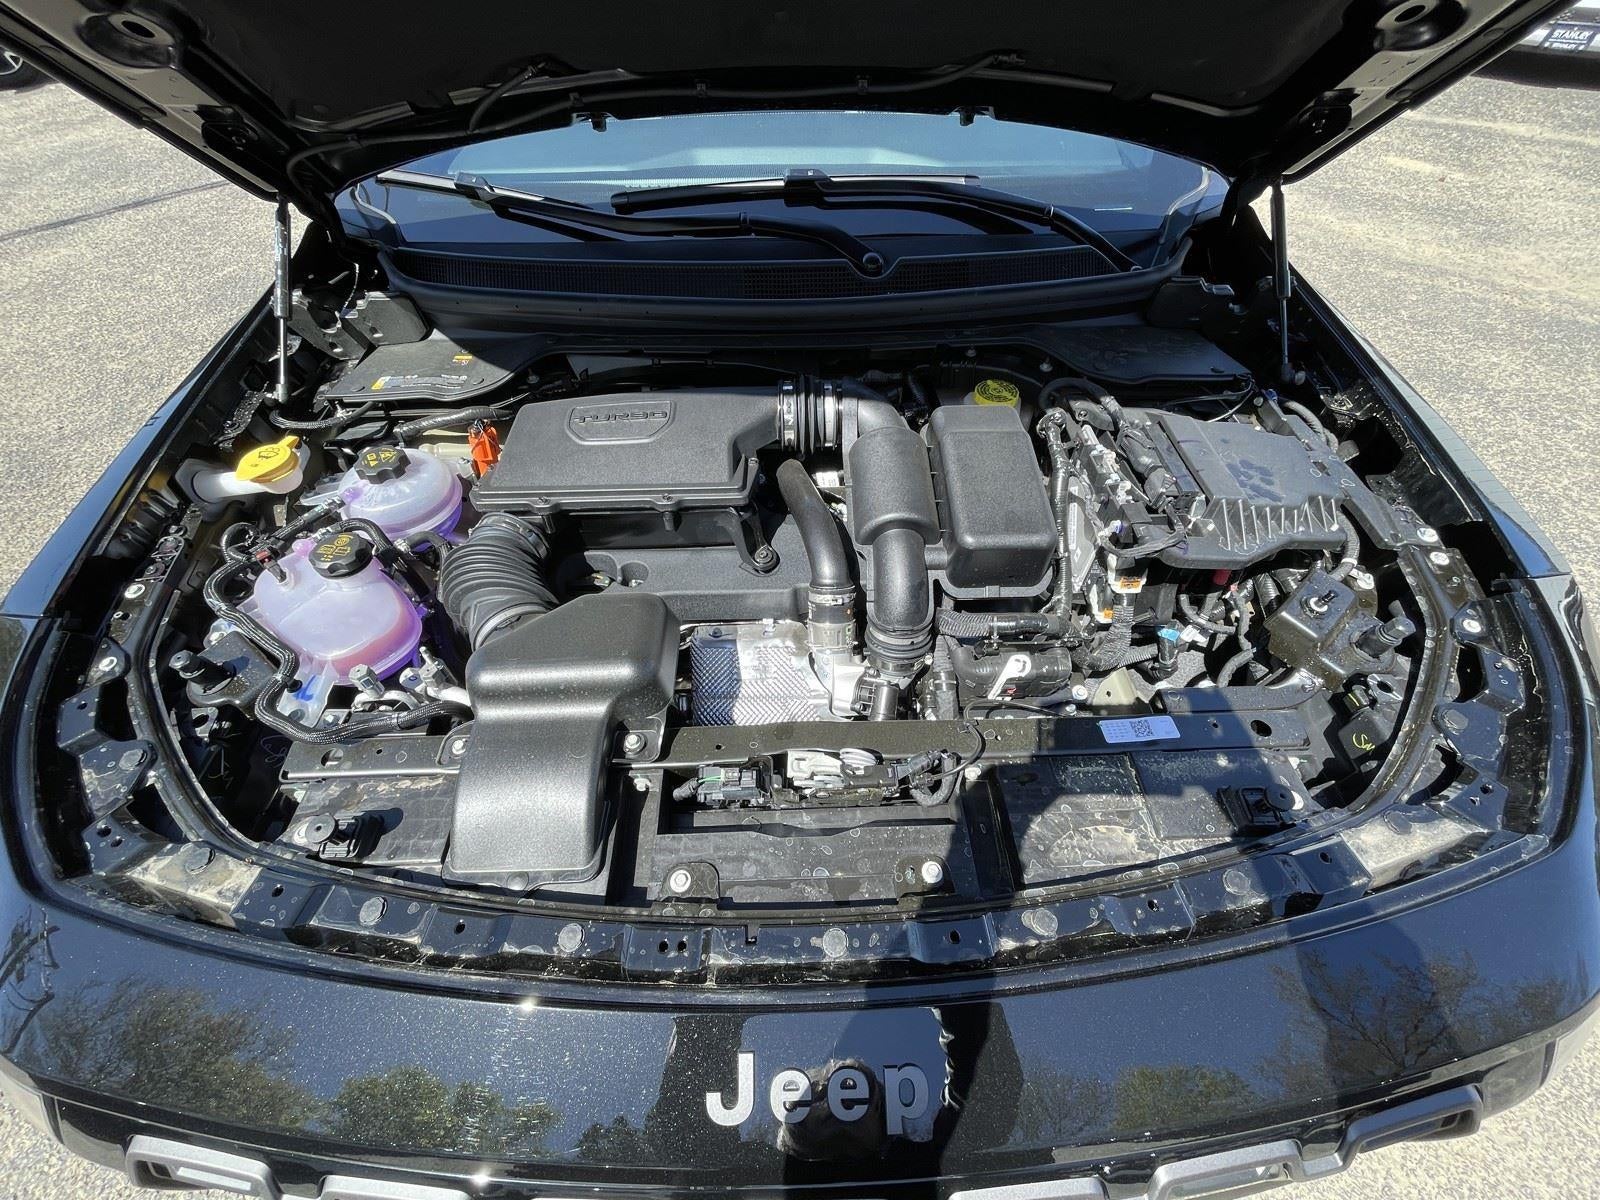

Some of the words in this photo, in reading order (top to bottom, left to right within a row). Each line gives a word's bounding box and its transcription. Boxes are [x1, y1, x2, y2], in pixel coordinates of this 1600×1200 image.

[1552, 29, 1594, 40] STANLEY
[573, 411, 668, 424] TURBO
[706, 1052, 929, 1136] Jeep
